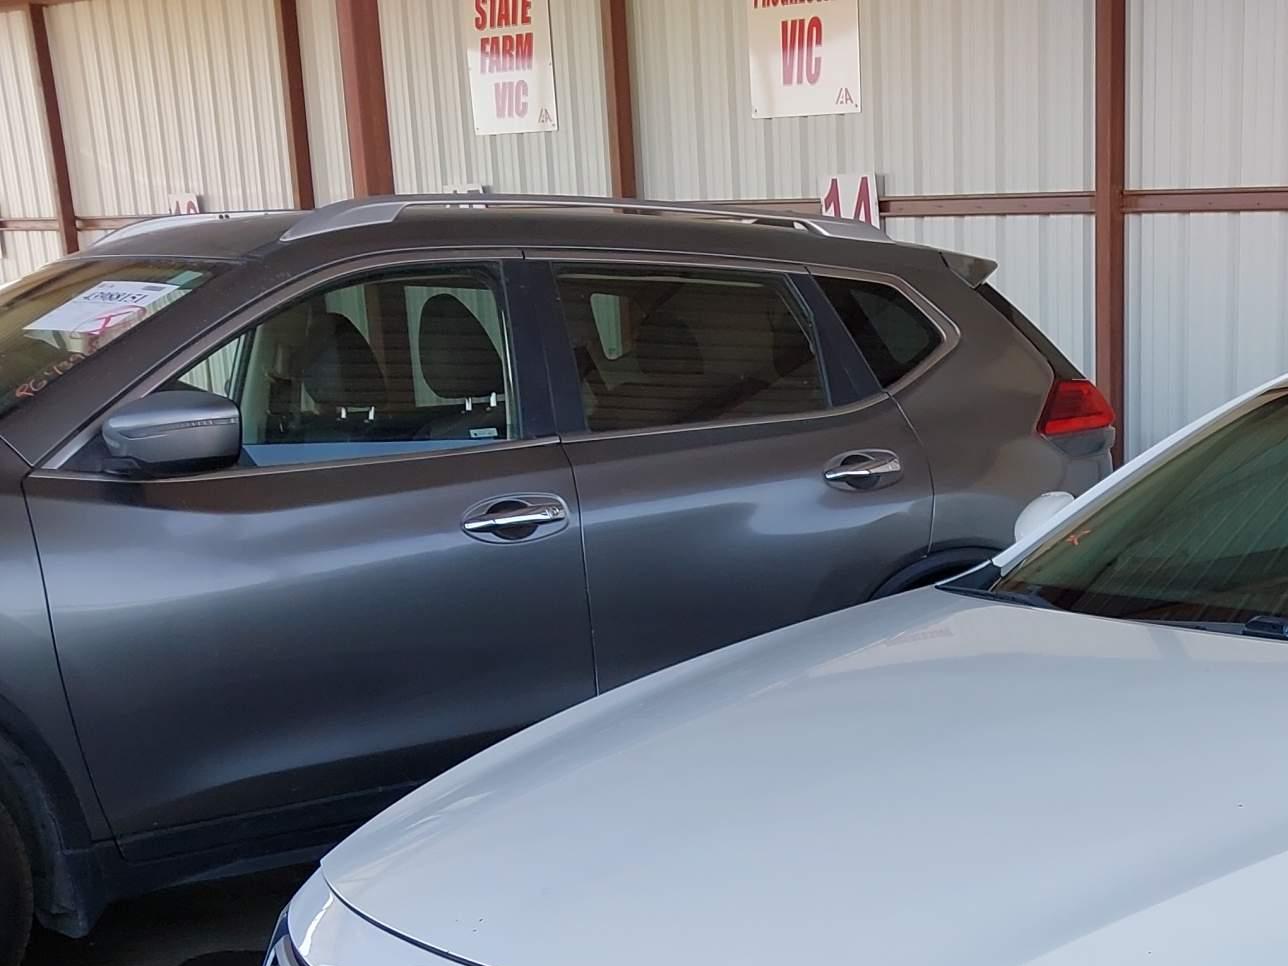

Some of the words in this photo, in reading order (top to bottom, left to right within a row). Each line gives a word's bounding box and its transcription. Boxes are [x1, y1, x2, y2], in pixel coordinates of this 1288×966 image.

[480, 32, 534, 74] FARM
[781, 16, 822, 85] VIC
[494, 80, 529, 119] VIC
